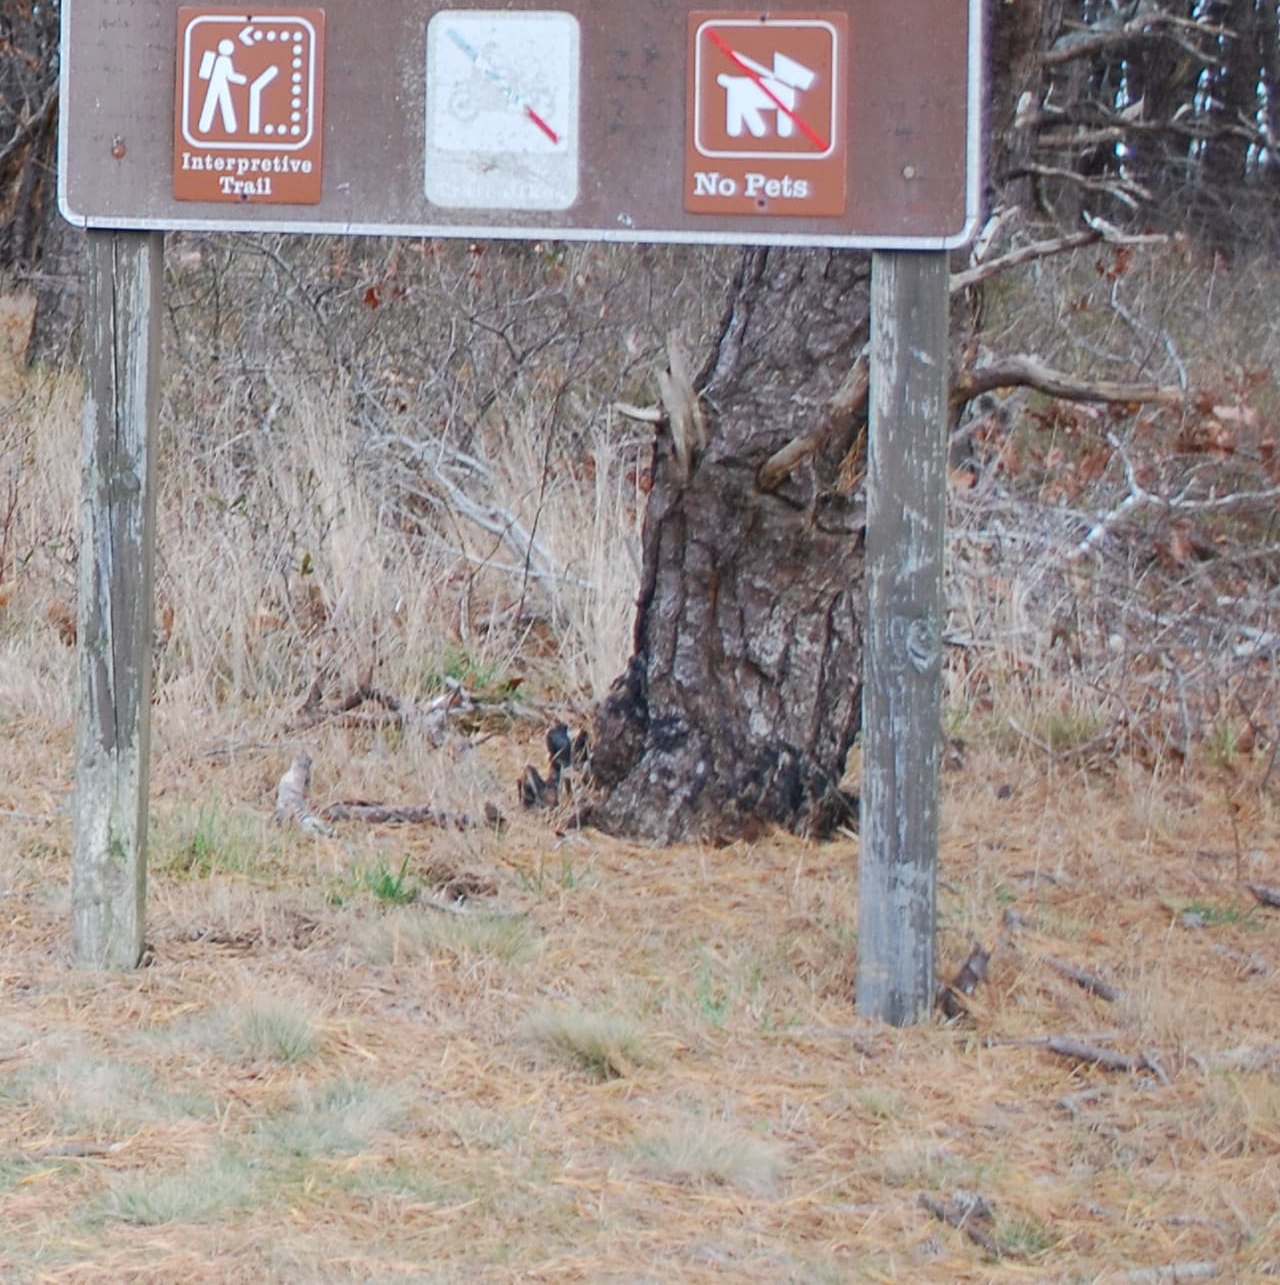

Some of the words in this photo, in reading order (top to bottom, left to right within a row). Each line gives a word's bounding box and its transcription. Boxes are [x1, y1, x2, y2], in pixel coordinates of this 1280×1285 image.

[181, 152, 312, 175] Interpretive
[219, 176, 272, 195] Trail
[693, 172, 736, 196] No
[744, 173, 808, 198] Pets
